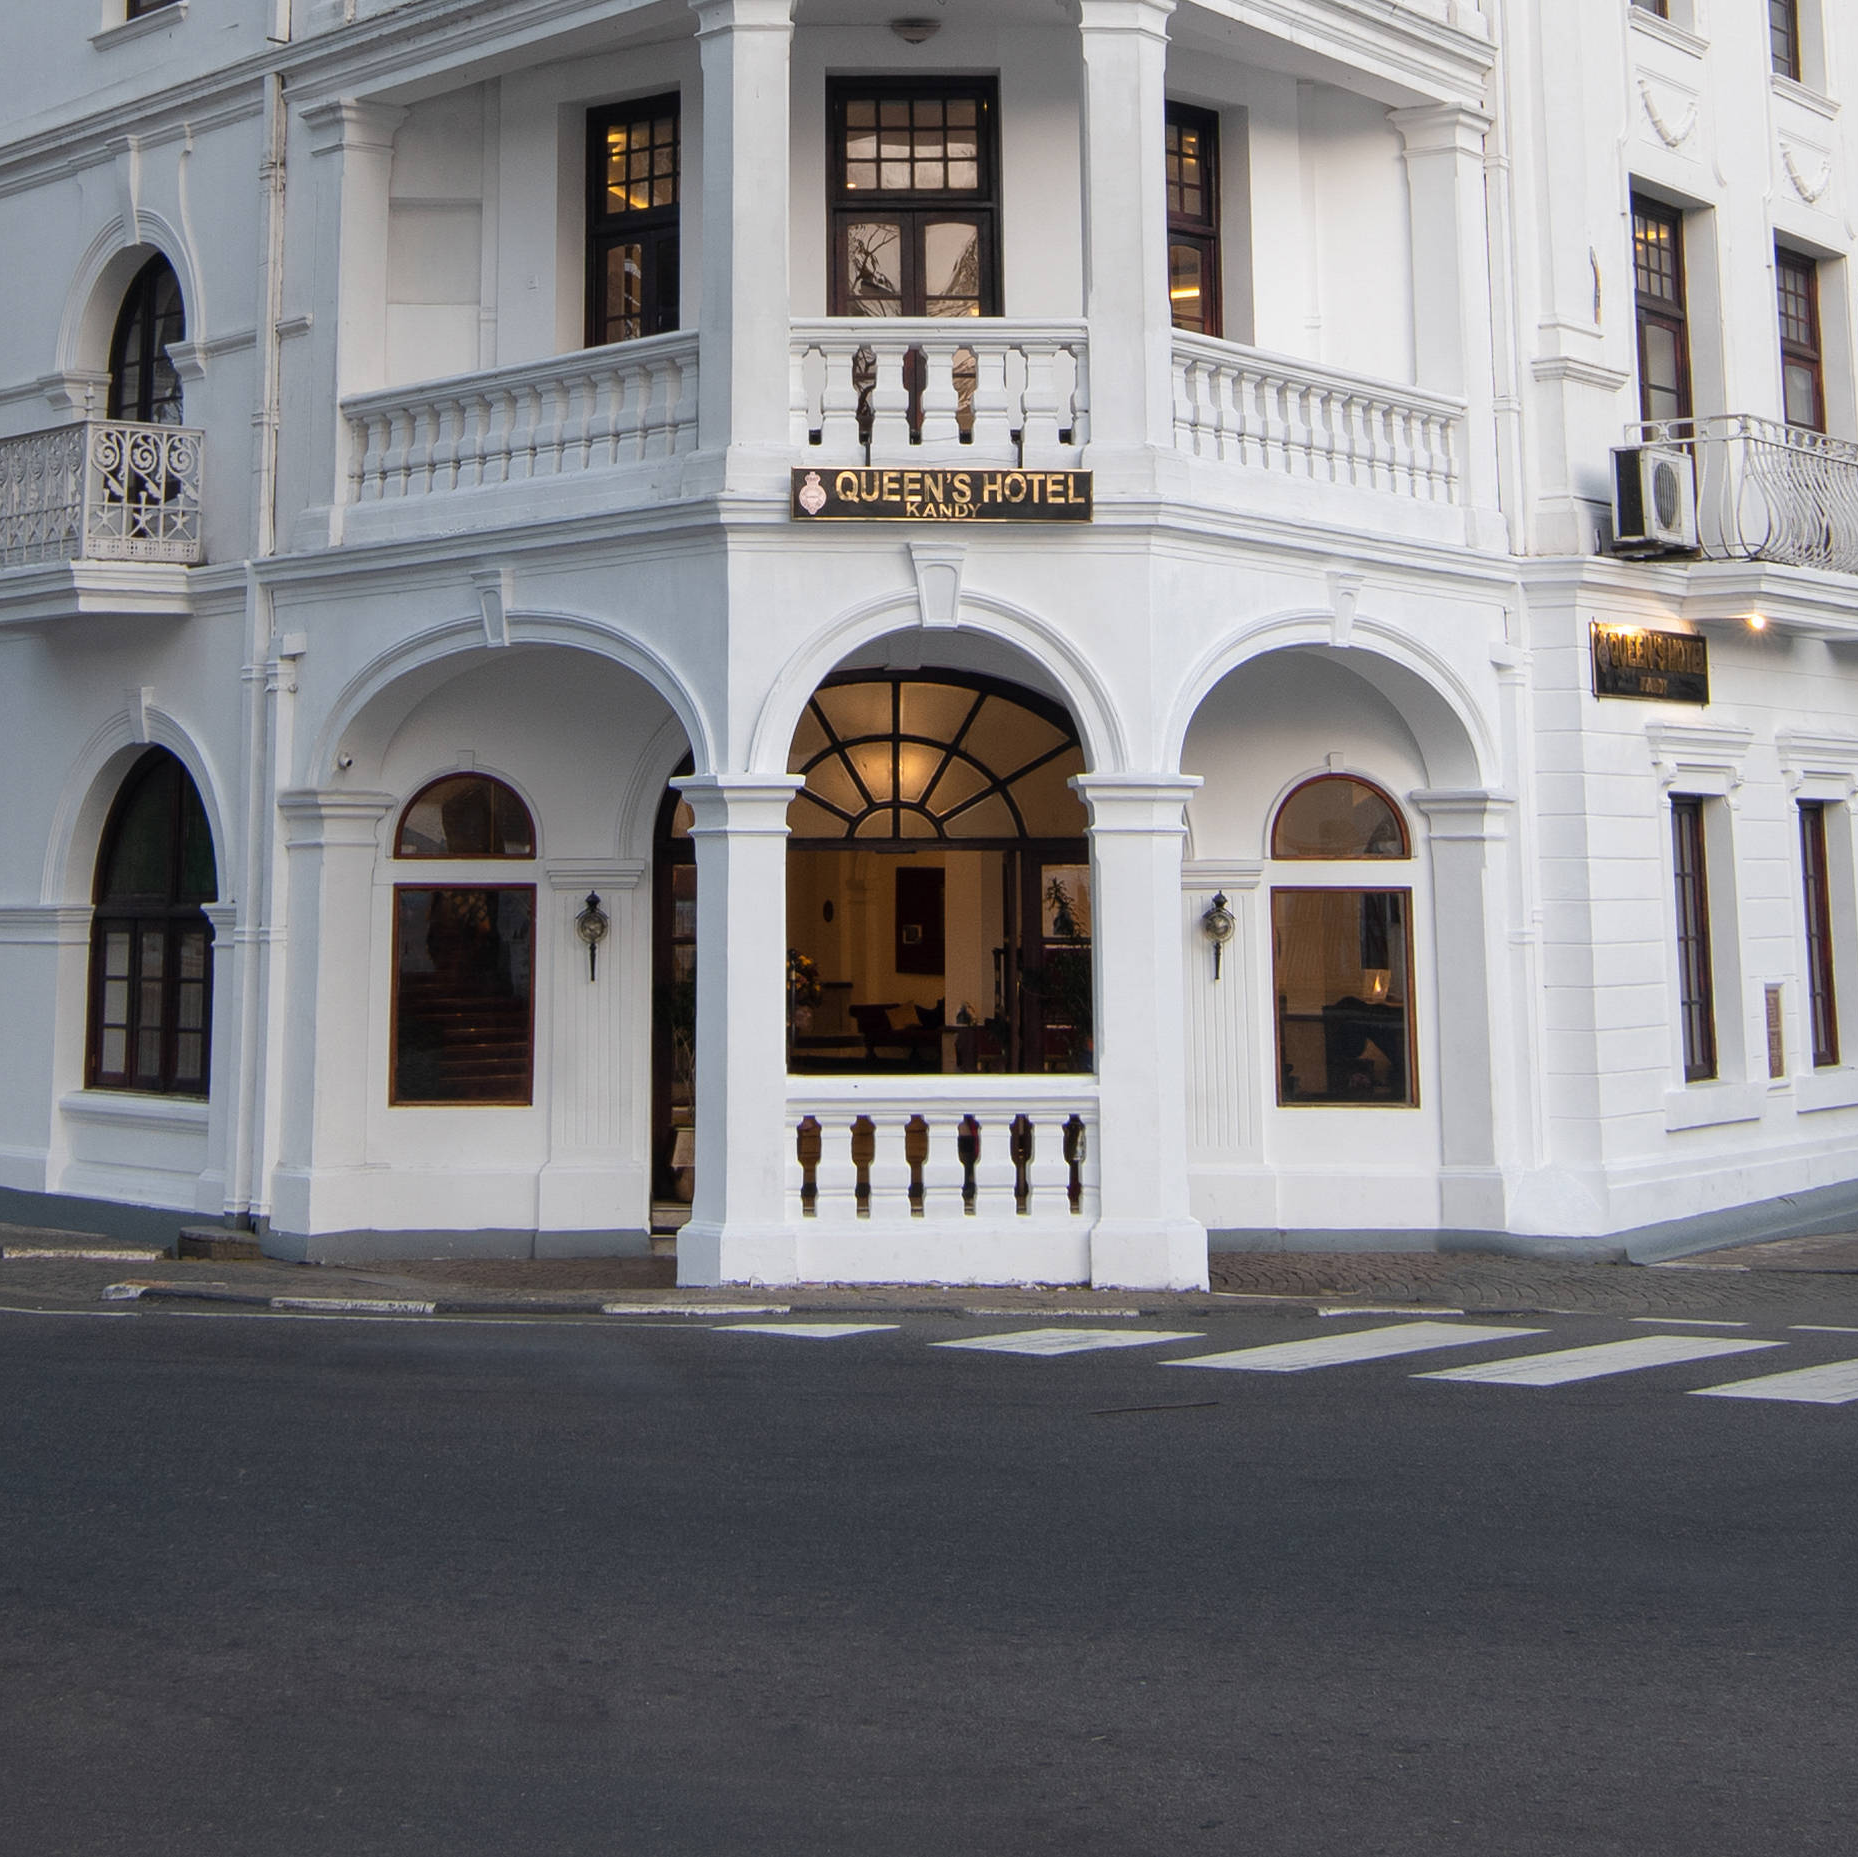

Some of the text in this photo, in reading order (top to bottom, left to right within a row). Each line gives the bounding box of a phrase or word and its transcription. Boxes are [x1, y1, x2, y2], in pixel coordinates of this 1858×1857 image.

[835, 470, 1086, 504] QUEEN'S HOTEL
[905, 502, 983, 519] KANDY
